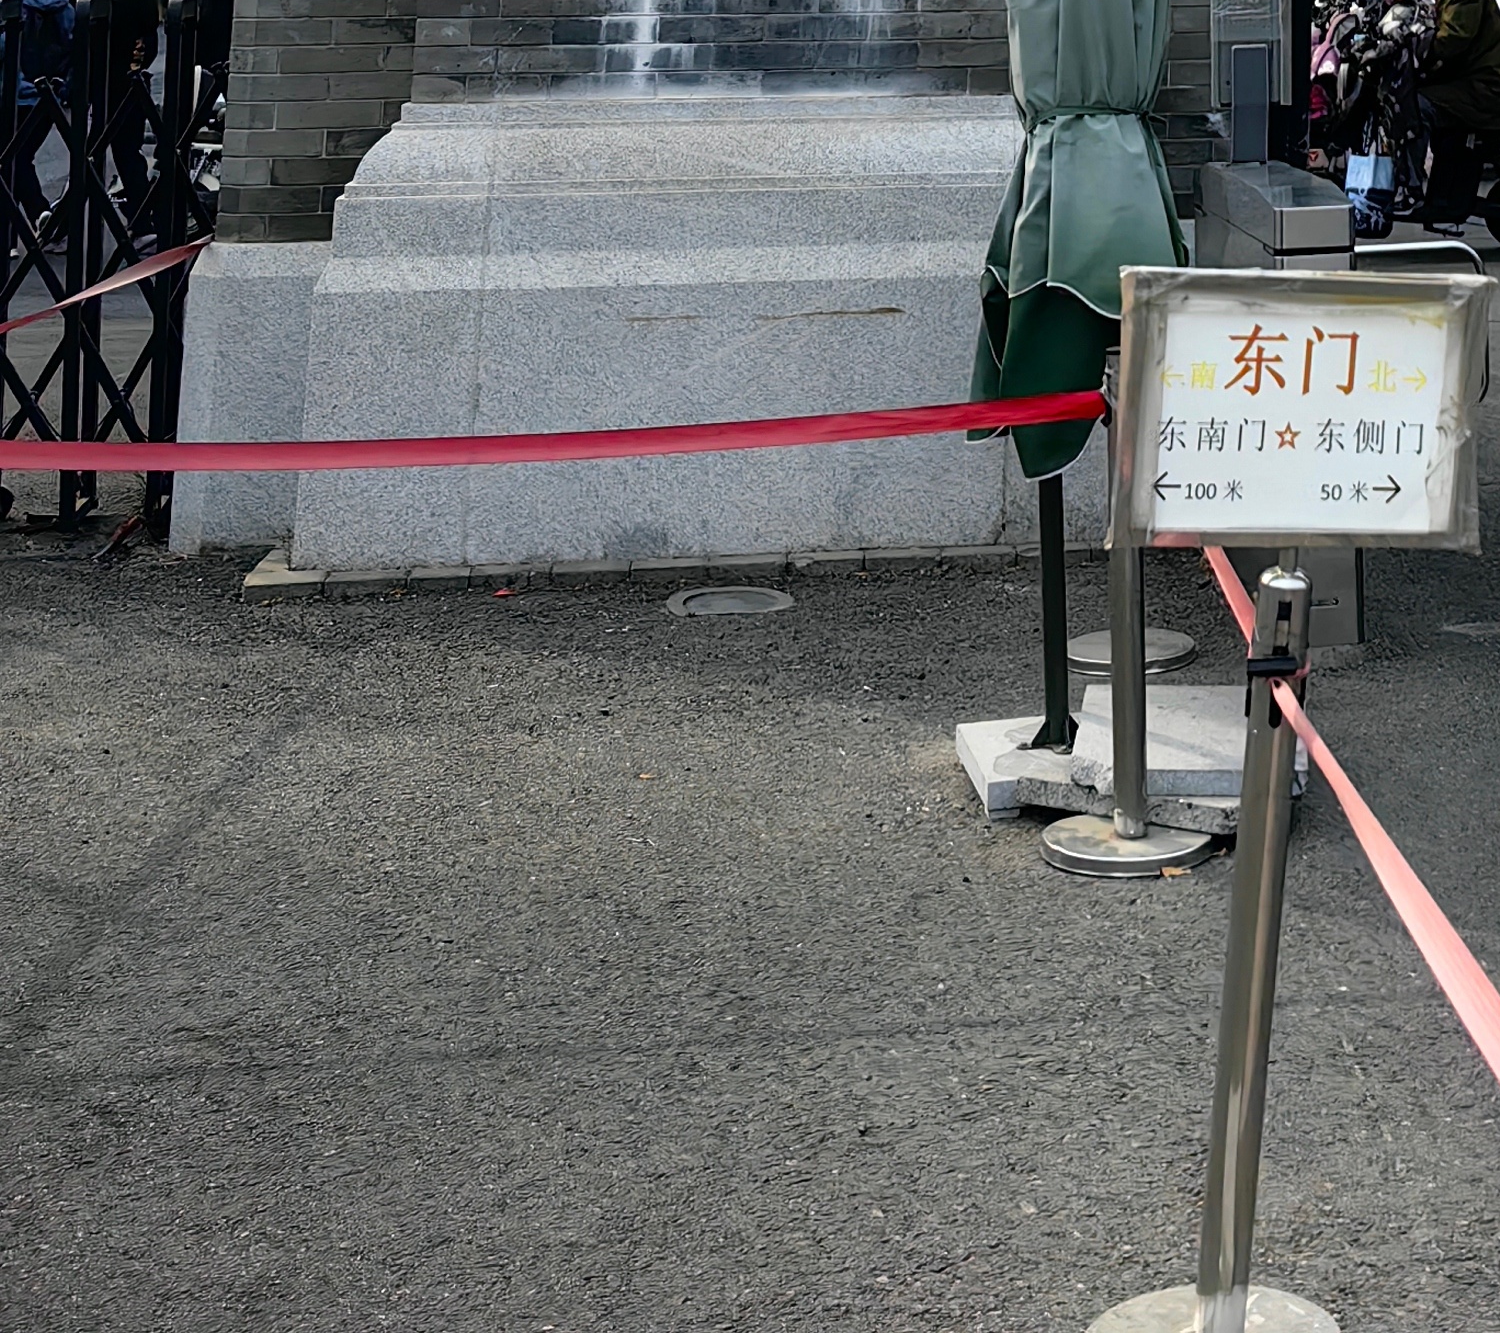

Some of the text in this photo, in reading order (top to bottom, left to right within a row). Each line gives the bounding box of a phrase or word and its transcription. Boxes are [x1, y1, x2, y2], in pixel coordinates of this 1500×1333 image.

[1190, 323, 1398, 397] 南 东门 北
[1158, 416, 1424, 455] 东南门 东侧门
